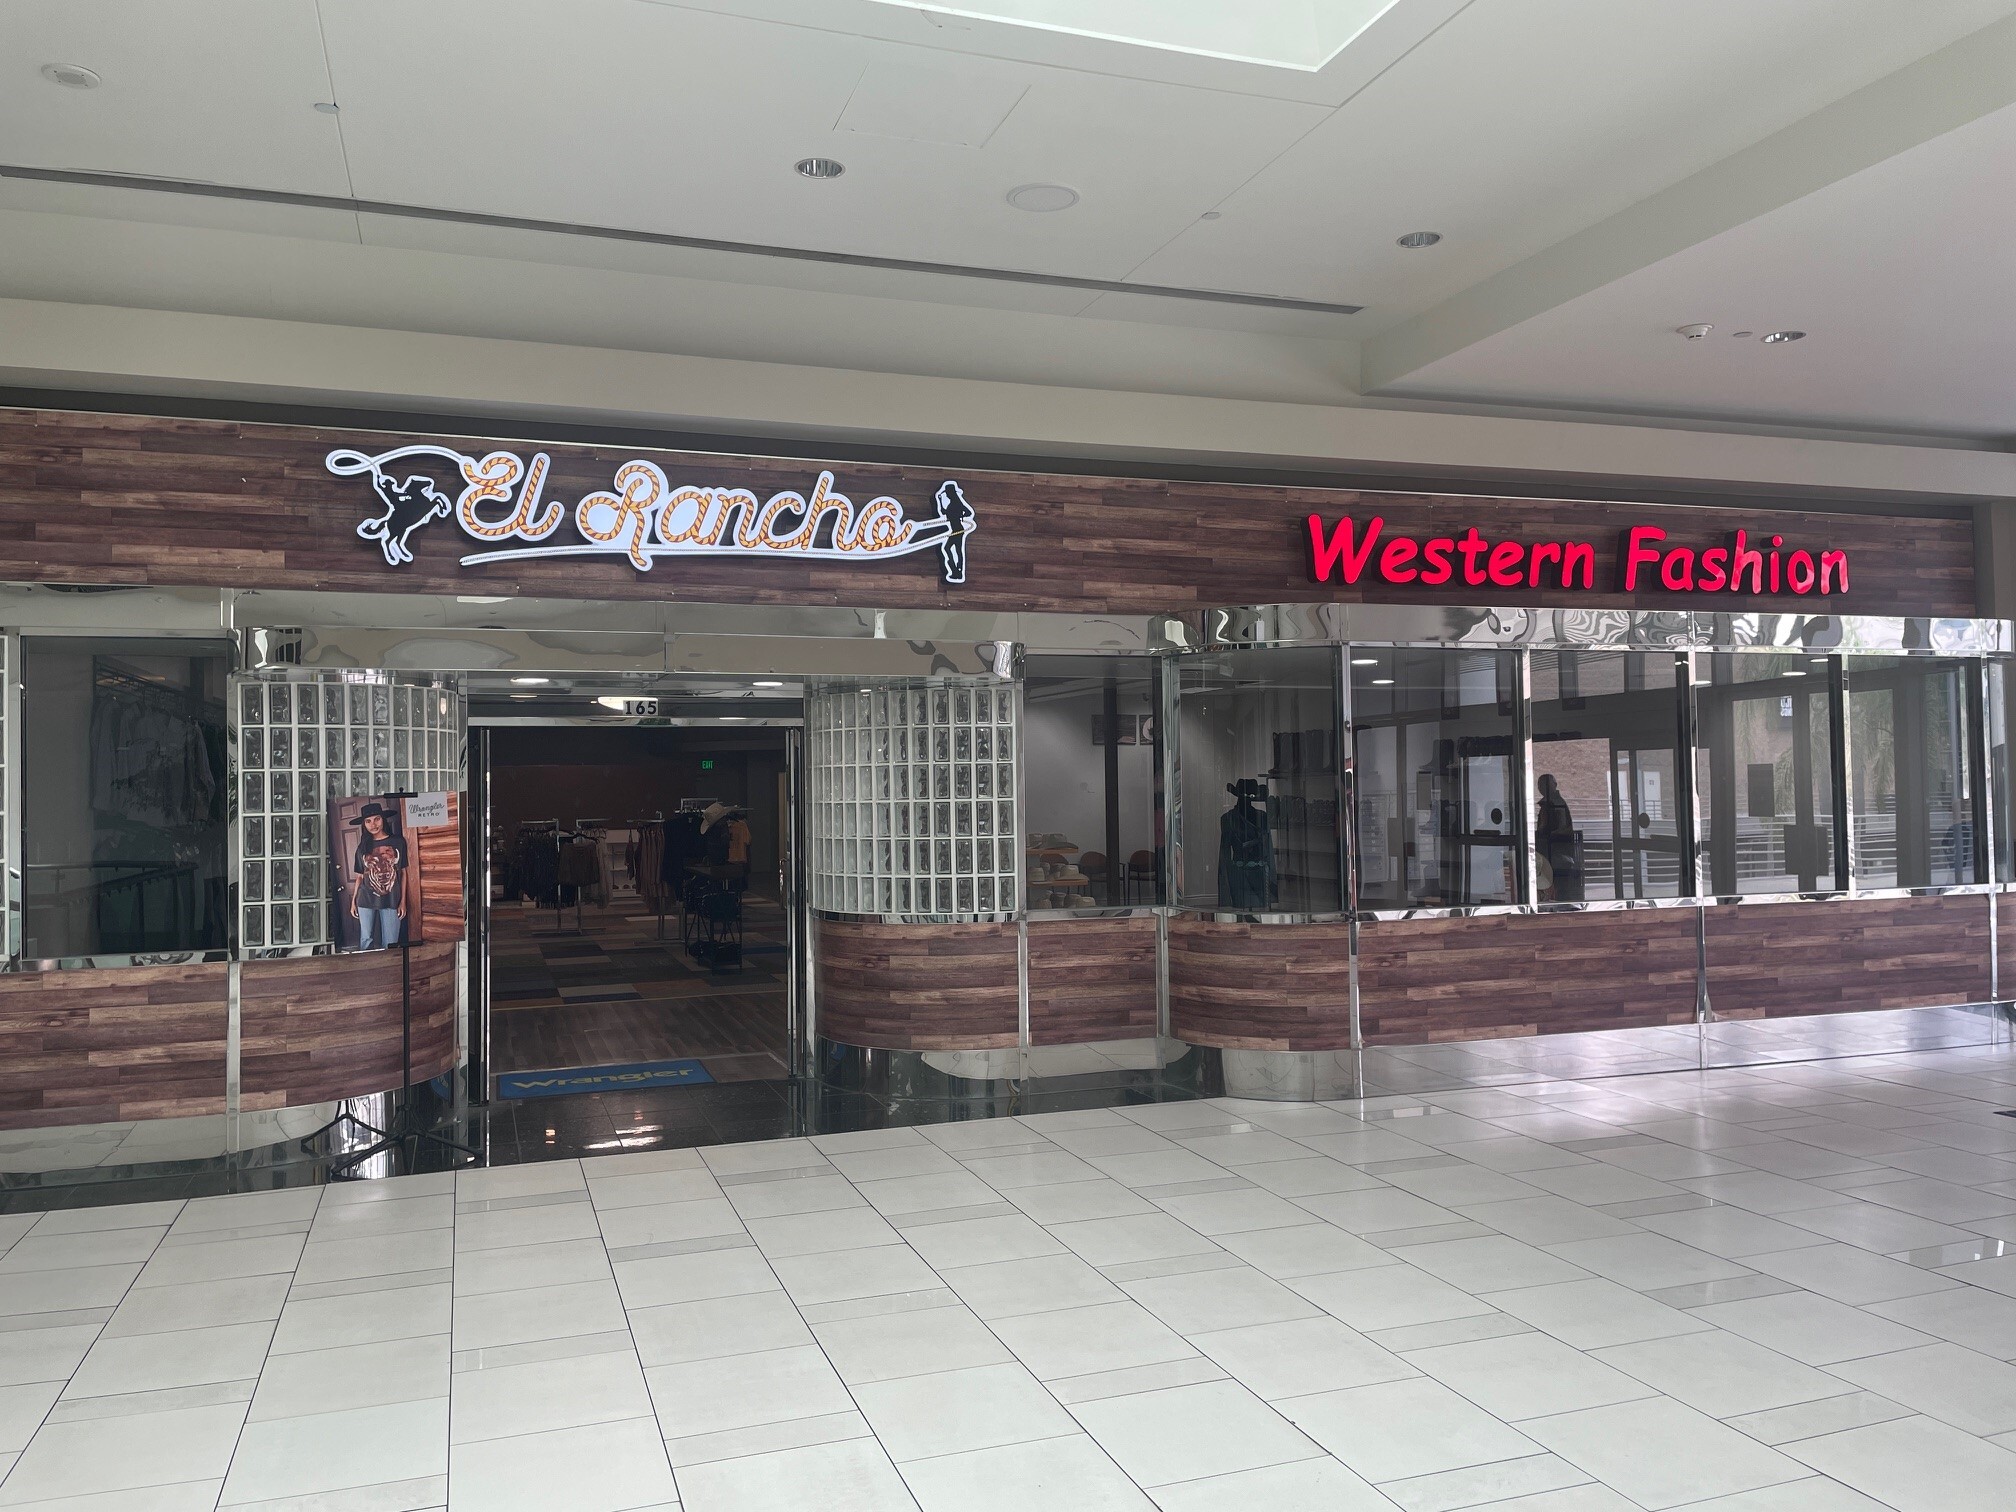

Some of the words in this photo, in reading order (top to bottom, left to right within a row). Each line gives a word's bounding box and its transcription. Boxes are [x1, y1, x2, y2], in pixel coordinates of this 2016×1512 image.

[461, 452, 562, 540] El
[577, 462, 913, 570] Rancho
[1308, 513, 1594, 589] Western
[1625, 526, 1849, 595] Fashion
[625, 700, 657, 715] 165
[702, 760, 714, 770] EXIT
[409, 802, 445, 813] Wrangler
